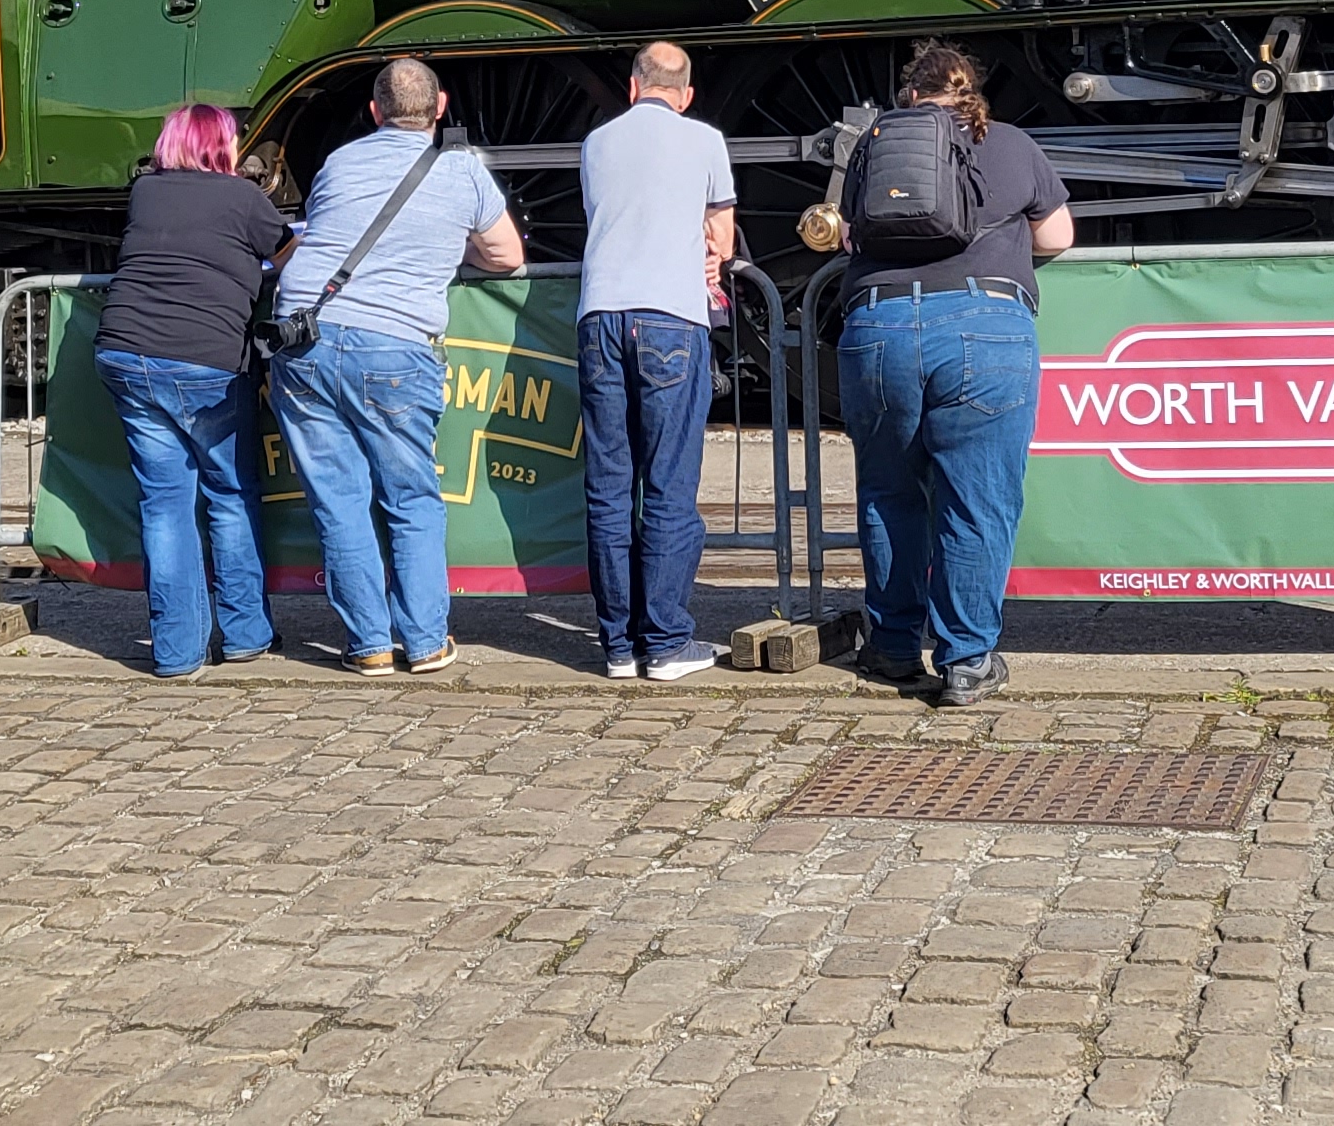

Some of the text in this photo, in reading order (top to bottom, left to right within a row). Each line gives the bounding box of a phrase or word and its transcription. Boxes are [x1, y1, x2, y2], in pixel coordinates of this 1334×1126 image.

[1058, 381, 1264, 426] WORTH
[490, 461, 537, 485] 2023
[1100, 573, 1191, 589] KEIGHLEY
[1196, 573, 1209, 589] &
[1212, 573, 1288, 589] WORTH
